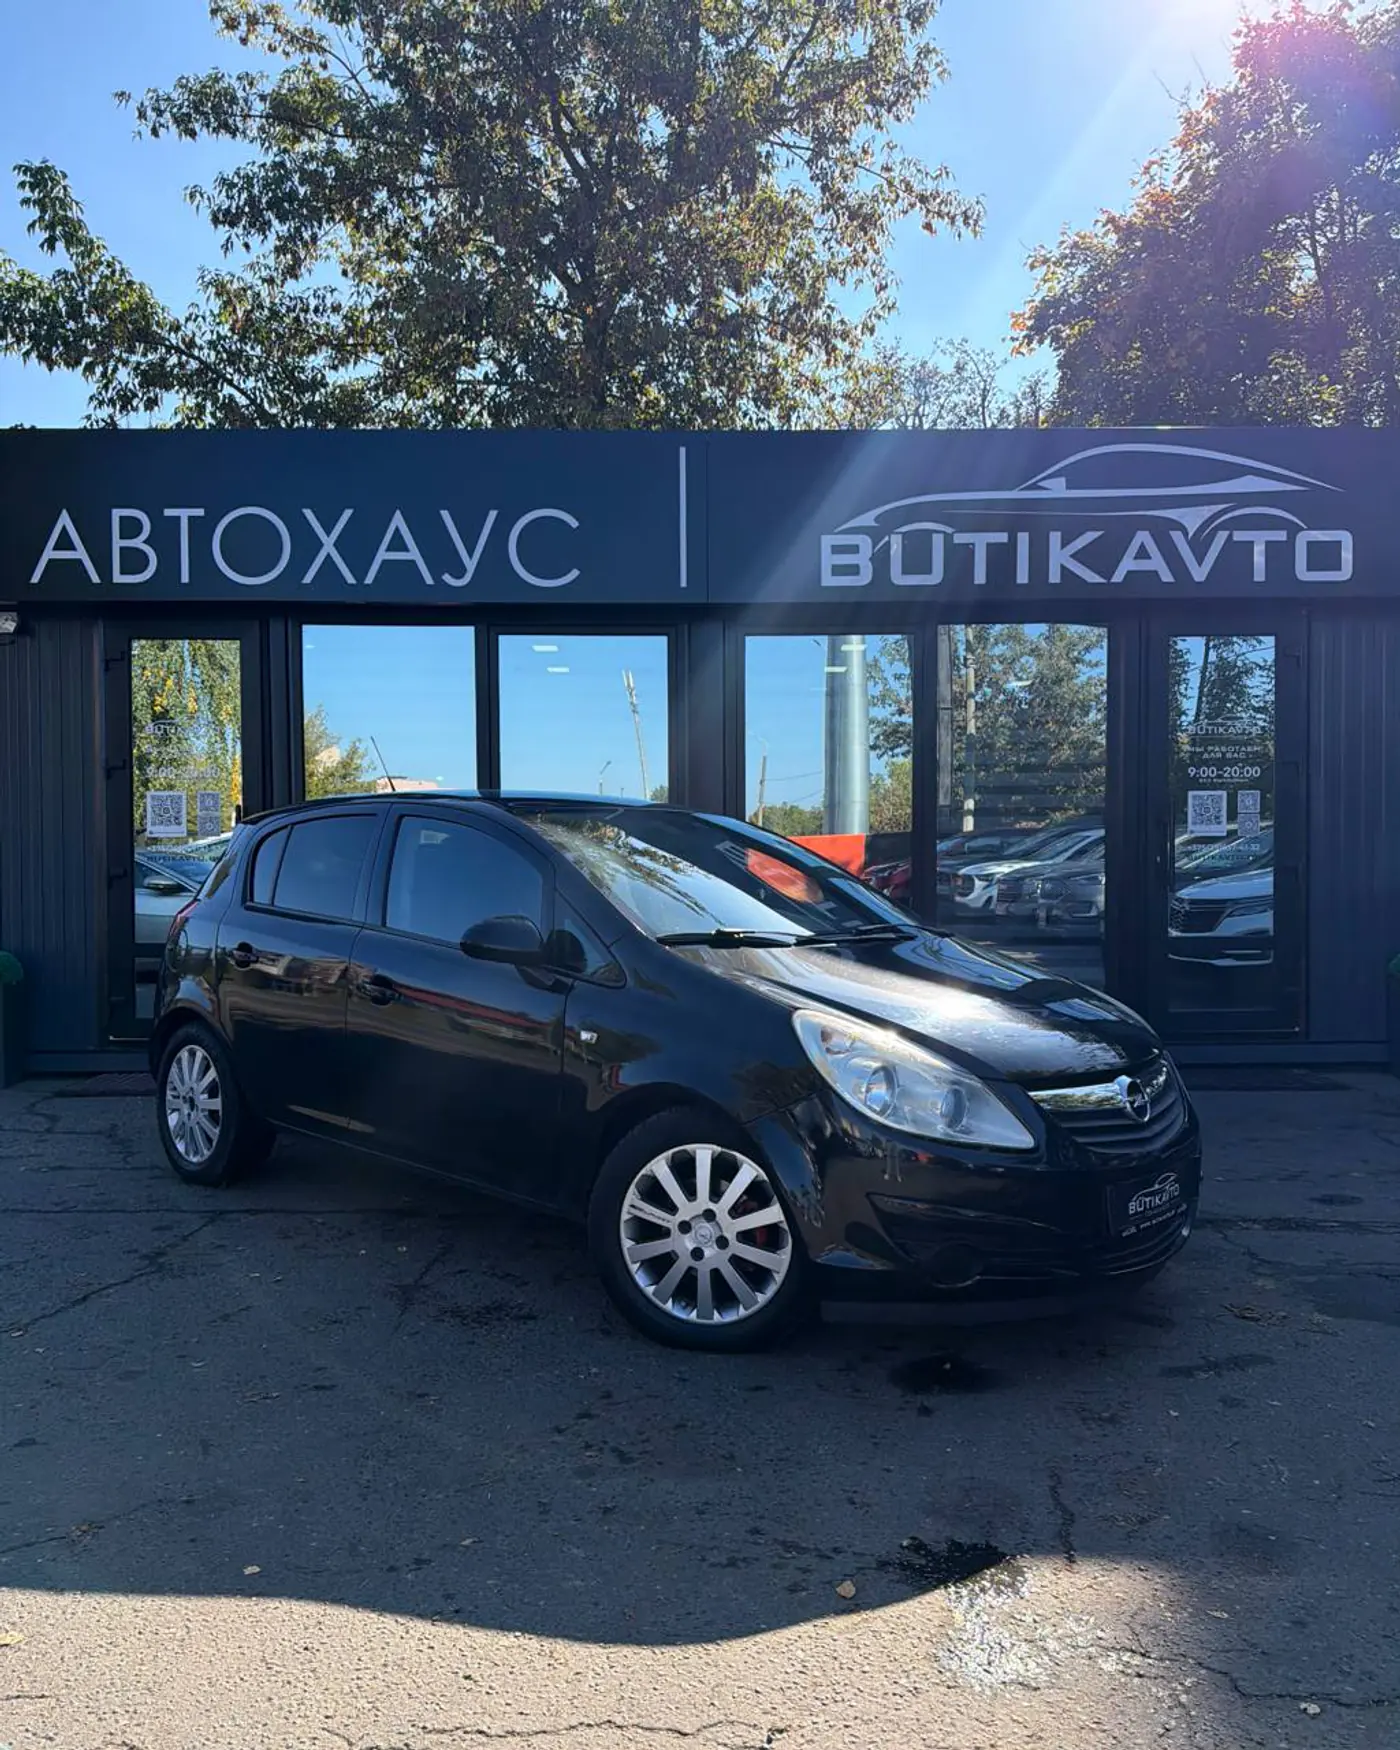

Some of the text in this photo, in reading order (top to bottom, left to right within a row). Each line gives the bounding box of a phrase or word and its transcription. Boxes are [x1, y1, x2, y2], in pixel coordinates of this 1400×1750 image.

[29, 506, 580, 586] АВТОХАУС
[820, 529, 1353, 587] BUTIKAVTO
[1188, 766, 1261, 778] 9:00-20:00
[1128, 1183, 1180, 1215] BUTIKAVTO
